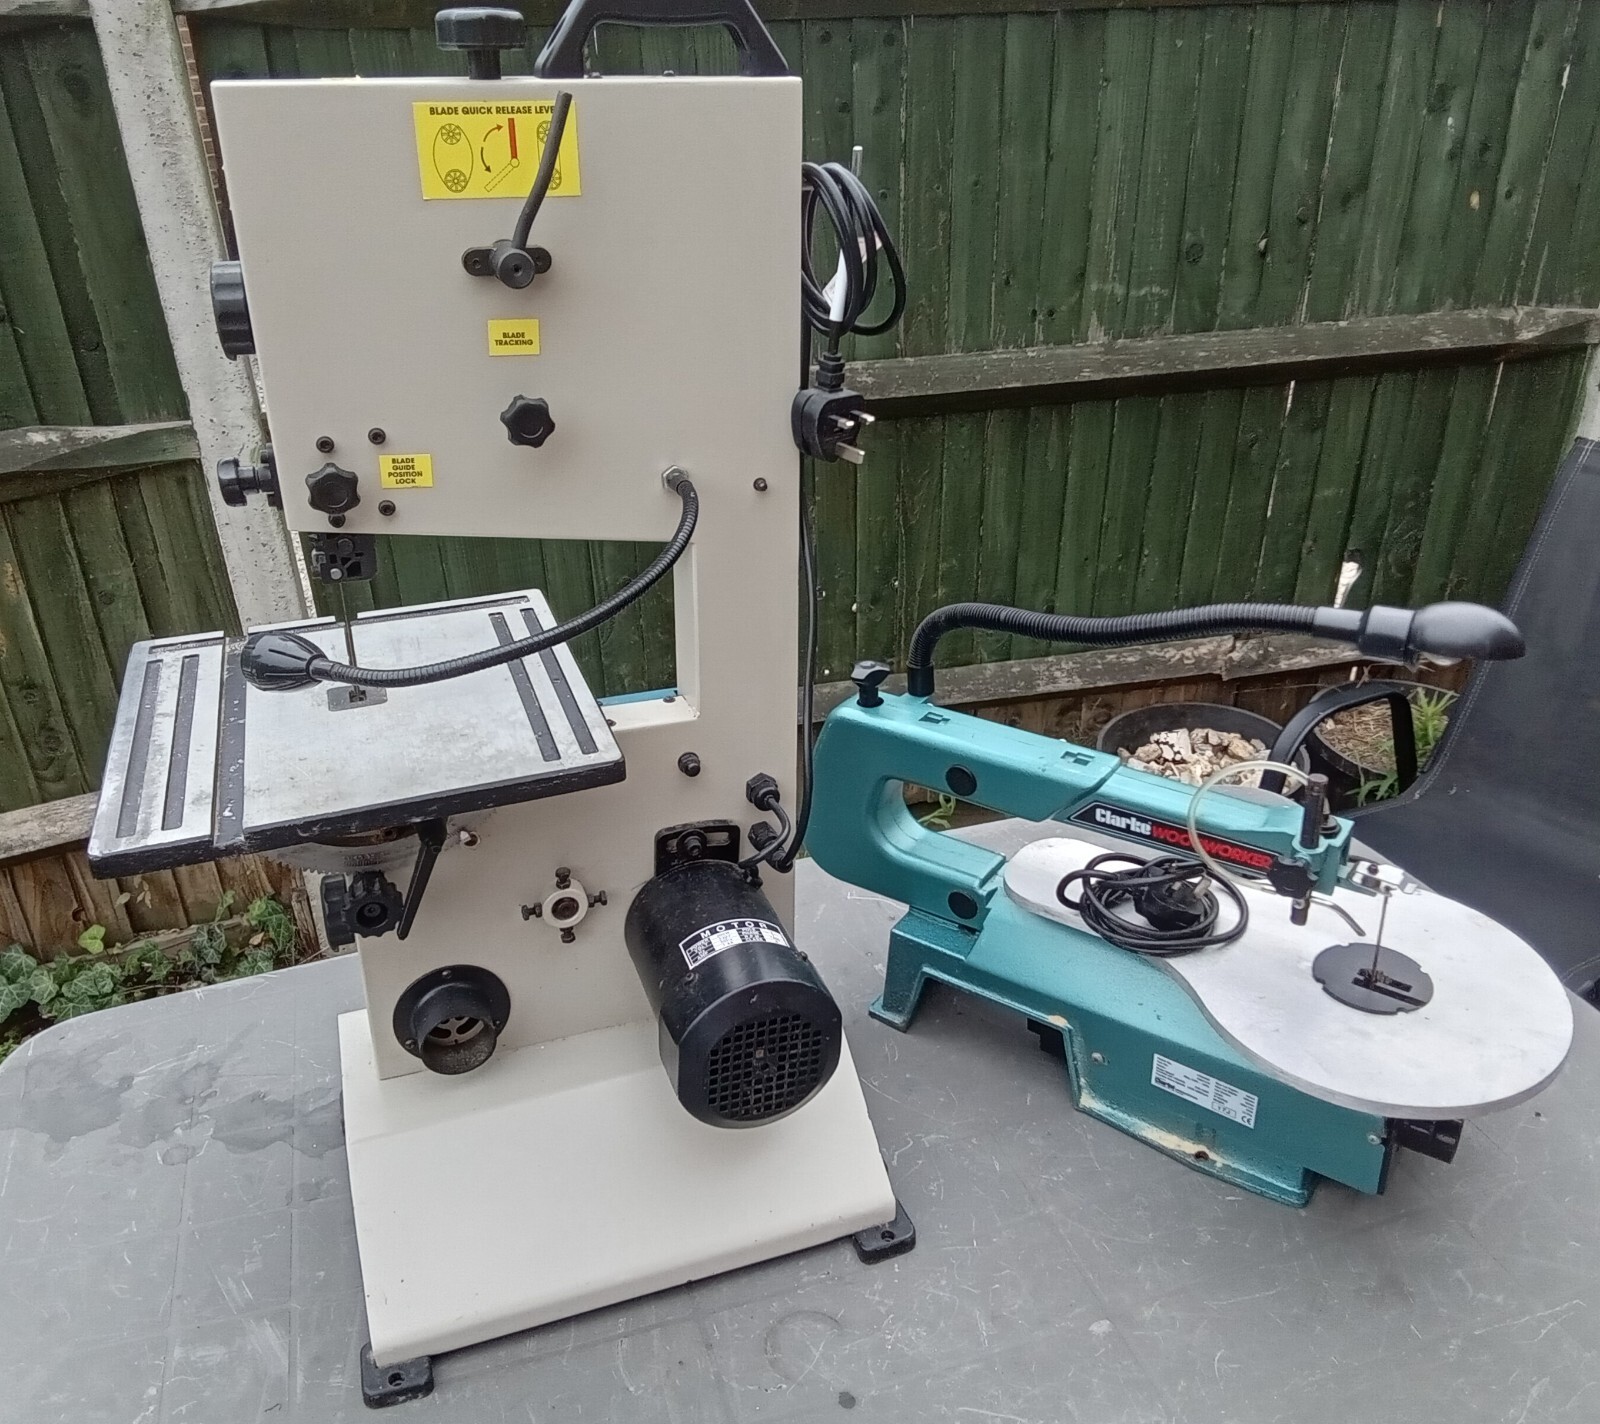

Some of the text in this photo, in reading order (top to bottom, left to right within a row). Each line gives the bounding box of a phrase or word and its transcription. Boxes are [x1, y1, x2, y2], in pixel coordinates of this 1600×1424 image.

[429, 105, 555, 115] BLADE QUICK RELEASE LEVE
[1095, 807, 1273, 869] Clarke WOOWORKER
[700, 921, 768, 939] MOTOR
